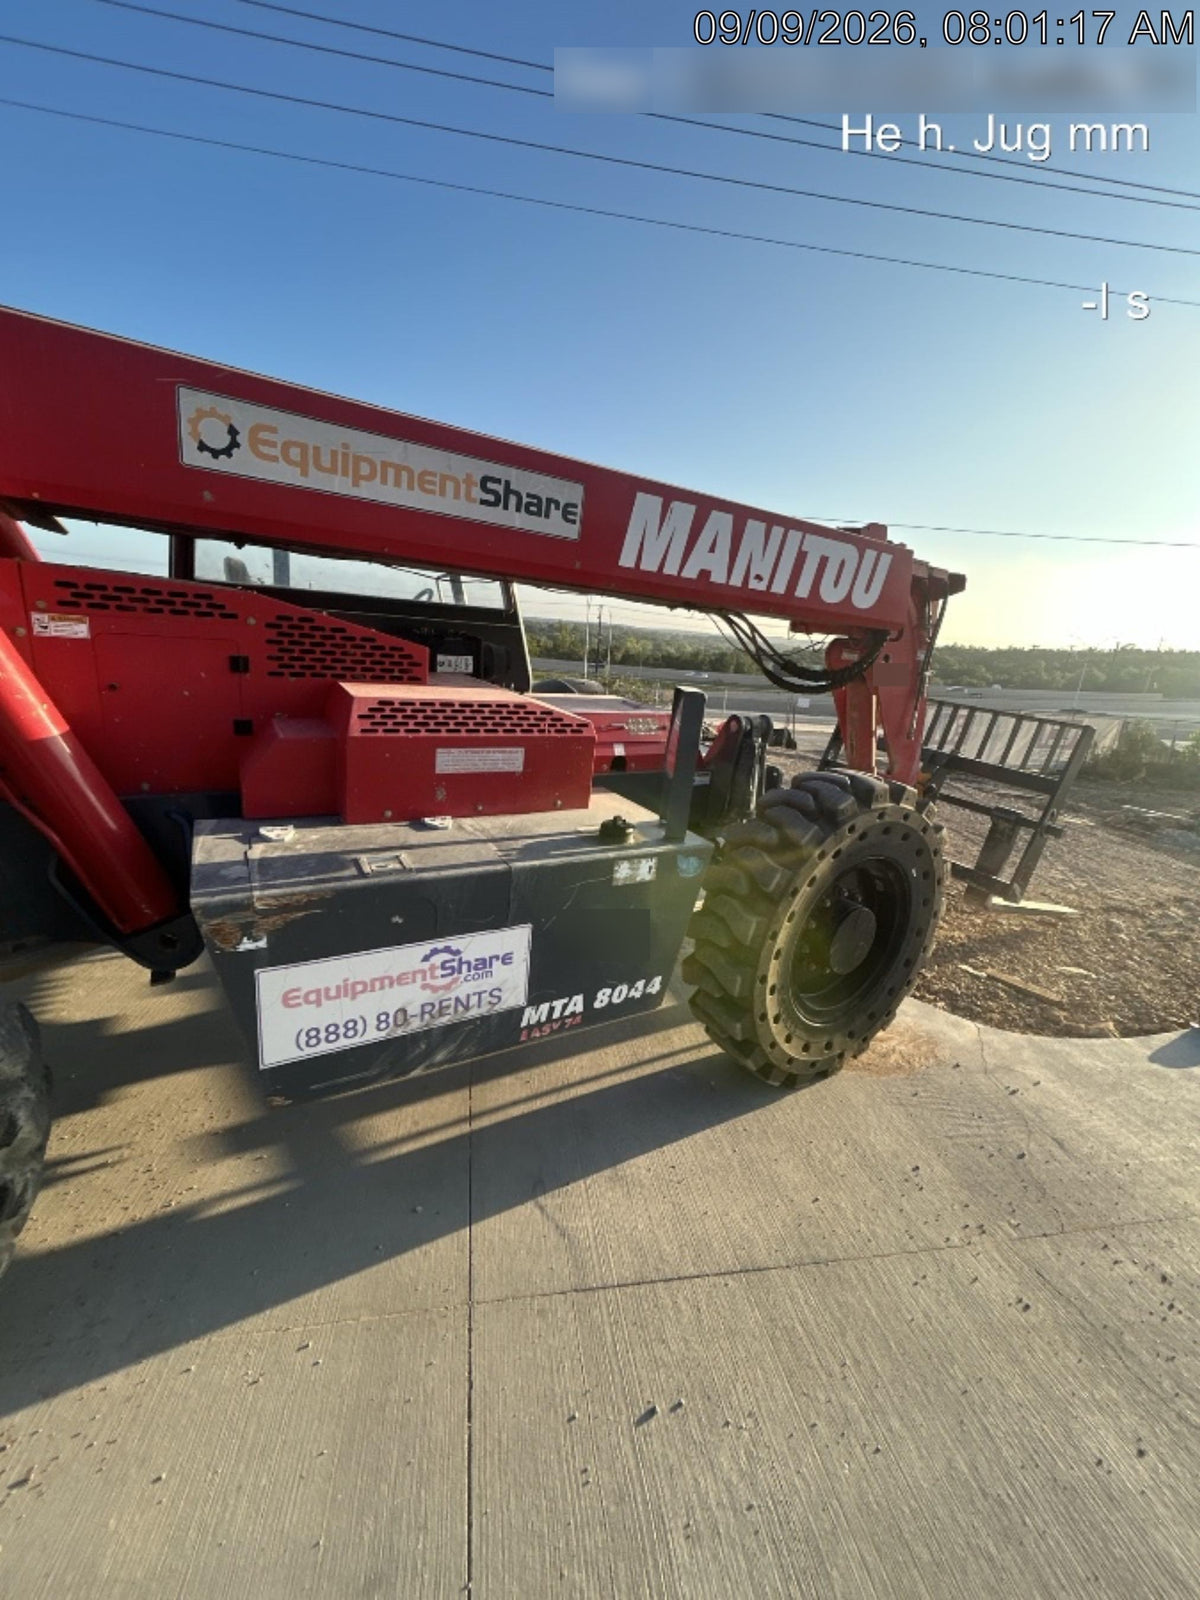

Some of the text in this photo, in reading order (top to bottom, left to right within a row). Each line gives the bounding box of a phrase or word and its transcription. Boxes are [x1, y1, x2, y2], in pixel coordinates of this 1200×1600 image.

[248, 422, 579, 525] EquipmentShare
[618, 491, 894, 609] MANITOU
[281, 951, 515, 1009] EquipmentShare
[520, 975, 663, 1028] MTA 8044
[294, 987, 503, 1052] (888) 80-RENTS
